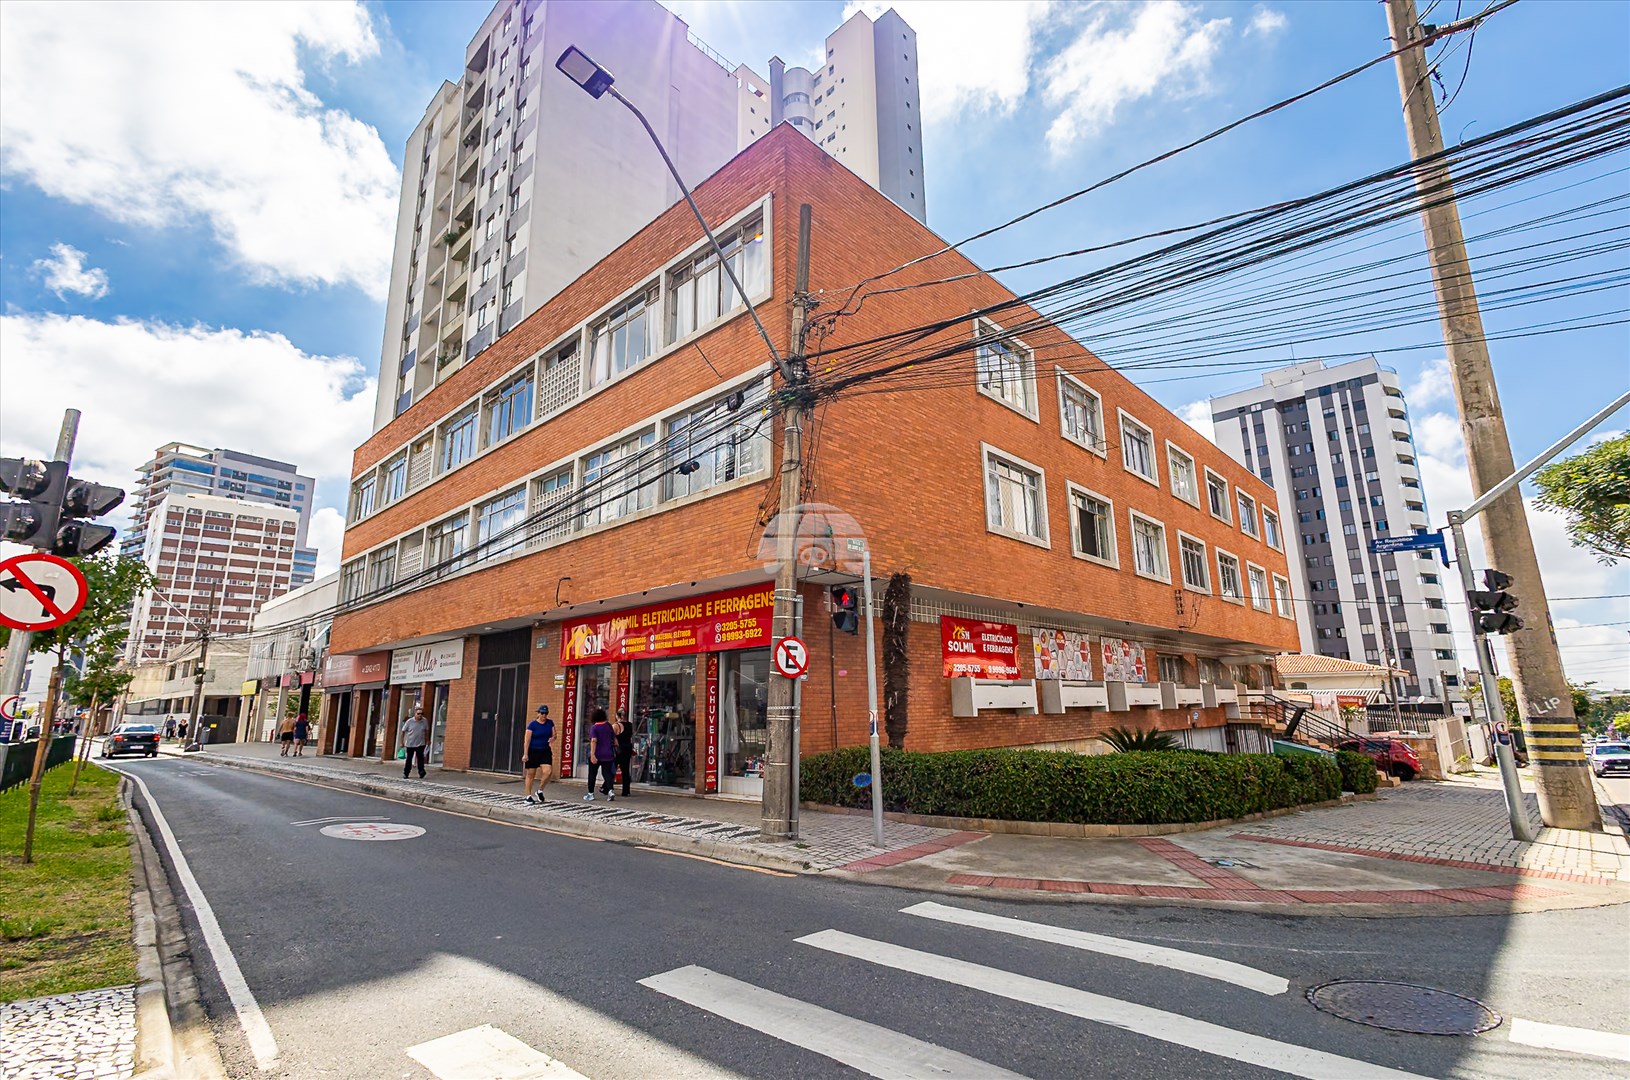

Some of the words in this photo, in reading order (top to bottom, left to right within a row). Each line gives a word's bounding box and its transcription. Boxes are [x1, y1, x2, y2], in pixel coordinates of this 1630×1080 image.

[642, 603, 703, 627] ELETRICIDADE
[705, 601, 712, 617] E
[714, 590, 775, 615] FERRAGENS
[721, 617, 757, 632] 3205-5755
[584, 634, 602, 655] SM
[948, 640, 976, 653] SOLMIL
[981, 633, 1013, 644] ELETRICIDADE
[983, 644, 987, 652] E
[987, 644, 1014, 654] FERRAGENS
[564, 690, 574, 758] PARAFUSOS
[708, 685, 716, 765] CHUVEIRO
